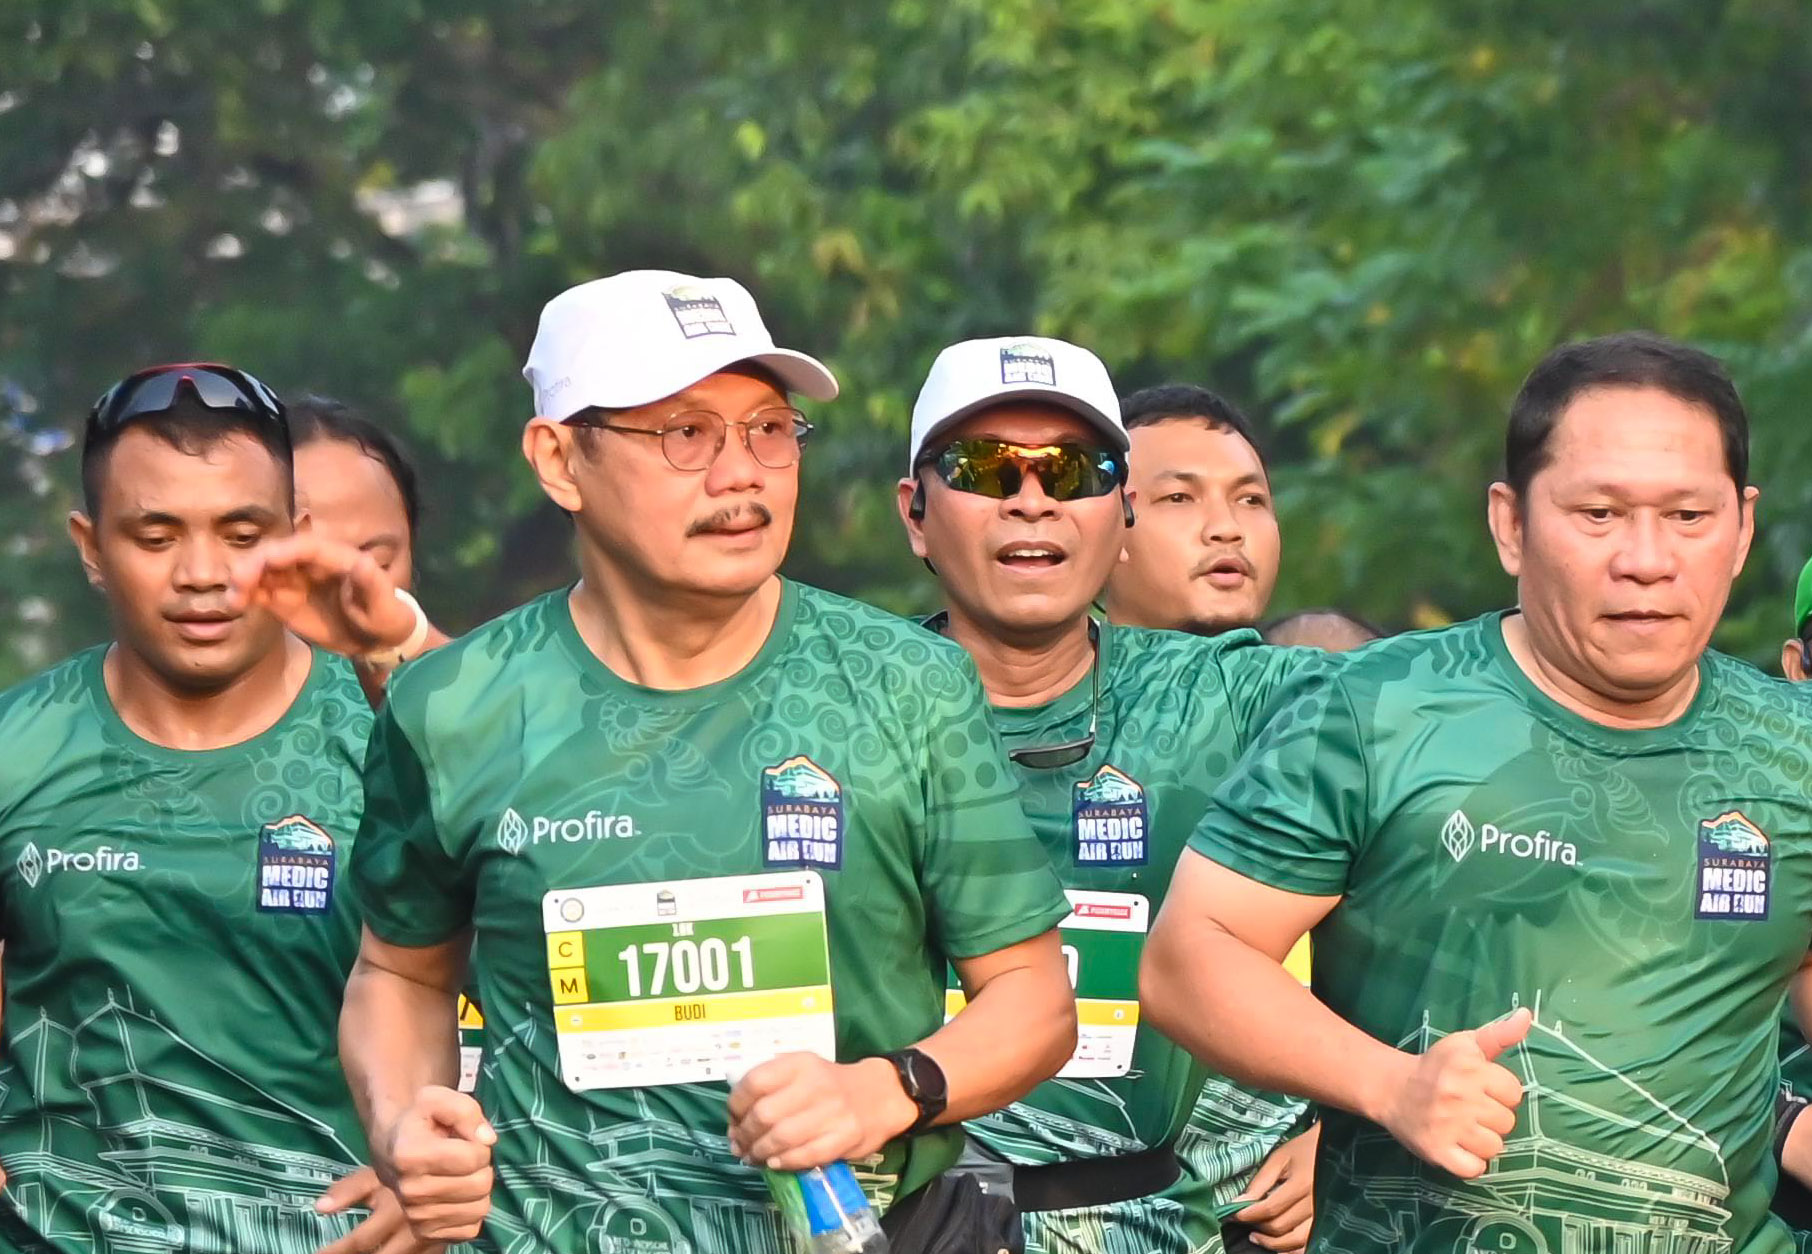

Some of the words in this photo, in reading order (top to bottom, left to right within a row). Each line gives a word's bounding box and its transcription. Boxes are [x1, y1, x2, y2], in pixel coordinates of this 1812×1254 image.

[533, 810, 633, 844] Profira
[767, 814, 837, 841] MEDIC
[1078, 816, 1143, 840] MEDIC
[768, 840, 799, 861] AIR
[1078, 842, 1107, 860] AIR
[1481, 823, 1577, 866] Profira
[47, 846, 140, 872] Profira
[262, 865, 329, 889] MEDIC
[1703, 867, 1766, 893] MEDIC
[261, 888, 290, 907] AIR
[1700, 893, 1730, 912] AIR
[558, 942, 573, 958] C
[618, 935, 754, 997] 17001
[560, 978, 578, 994] M
[674, 1003, 706, 1021] BUDI
